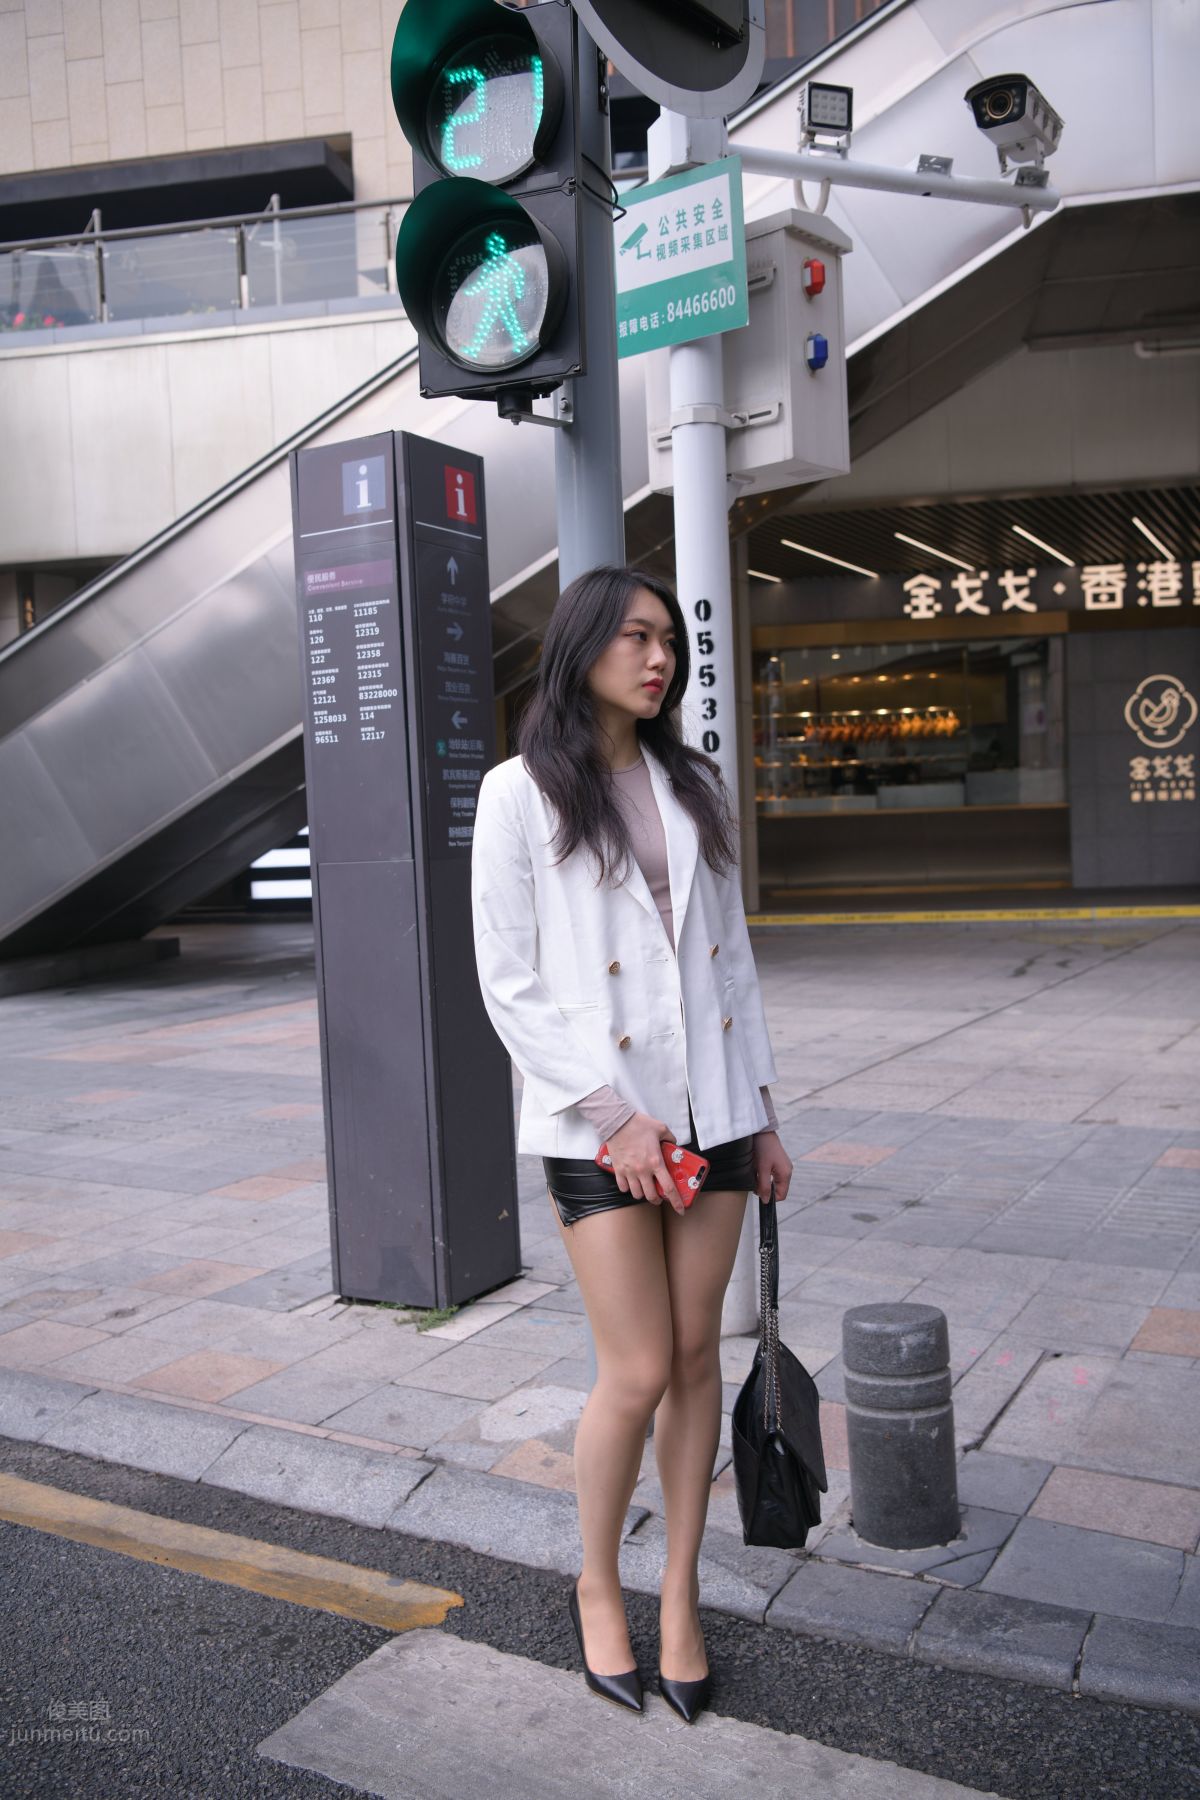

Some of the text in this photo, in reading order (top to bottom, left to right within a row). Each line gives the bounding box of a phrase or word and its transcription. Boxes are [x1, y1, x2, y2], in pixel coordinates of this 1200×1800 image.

[657, 198, 725, 238] 公共安全
[656, 223, 730, 262] 视频采集区域
[903, 560, 1200, 619] 金戈戈·香港
[353, 606, 378, 618] 11185
[308, 614, 323, 623] 110
[355, 627, 380, 638] 12319
[310, 635, 324, 645] 120
[311, 655, 325, 665] 122
[356, 649, 381, 660] 12358
[357, 669, 382, 680] 12315
[694, 599, 720, 753] 05530
[312, 675, 336, 686] 12369
[313, 695, 337, 705] 12121
[314, 713, 347, 725] 1258033
[360, 711, 375, 721] 114
[315, 734, 339, 744] 96511
[361, 730, 386, 741] 12117
